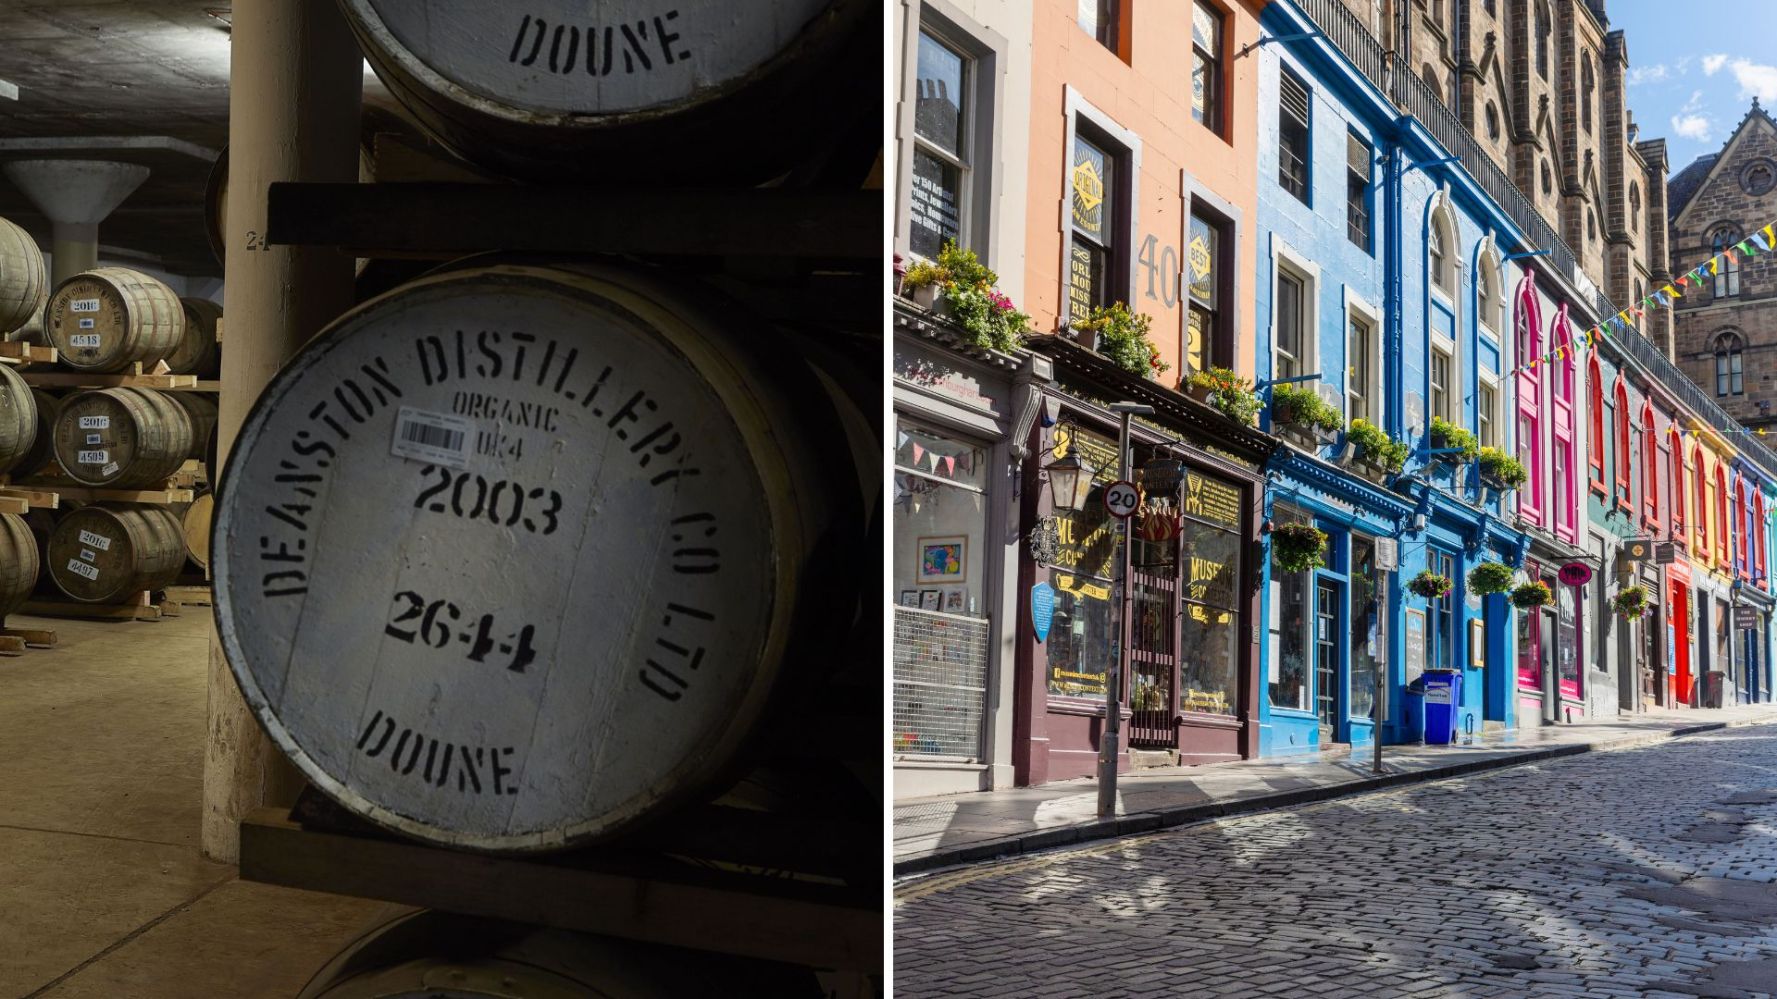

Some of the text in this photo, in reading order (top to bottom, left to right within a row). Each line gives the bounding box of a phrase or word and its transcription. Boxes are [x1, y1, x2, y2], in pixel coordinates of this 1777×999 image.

[509, 10, 691, 76] DOUNE
[921, 177, 932, 191] 150
[1138, 233, 1178, 309] 40
[1190, 247, 1208, 268] BEST
[74, 302, 97, 311] 2016
[453, 391, 559, 432] ORGANIC
[262, 329, 720, 703] DEANSTON DISTILLERY CO LTD
[414, 464, 563, 535] 2003
[1110, 490, 1136, 509] 20
[83, 532, 107, 549] 2016
[385, 590, 538, 674] 2644
[355, 709, 522, 796] DOUNE
